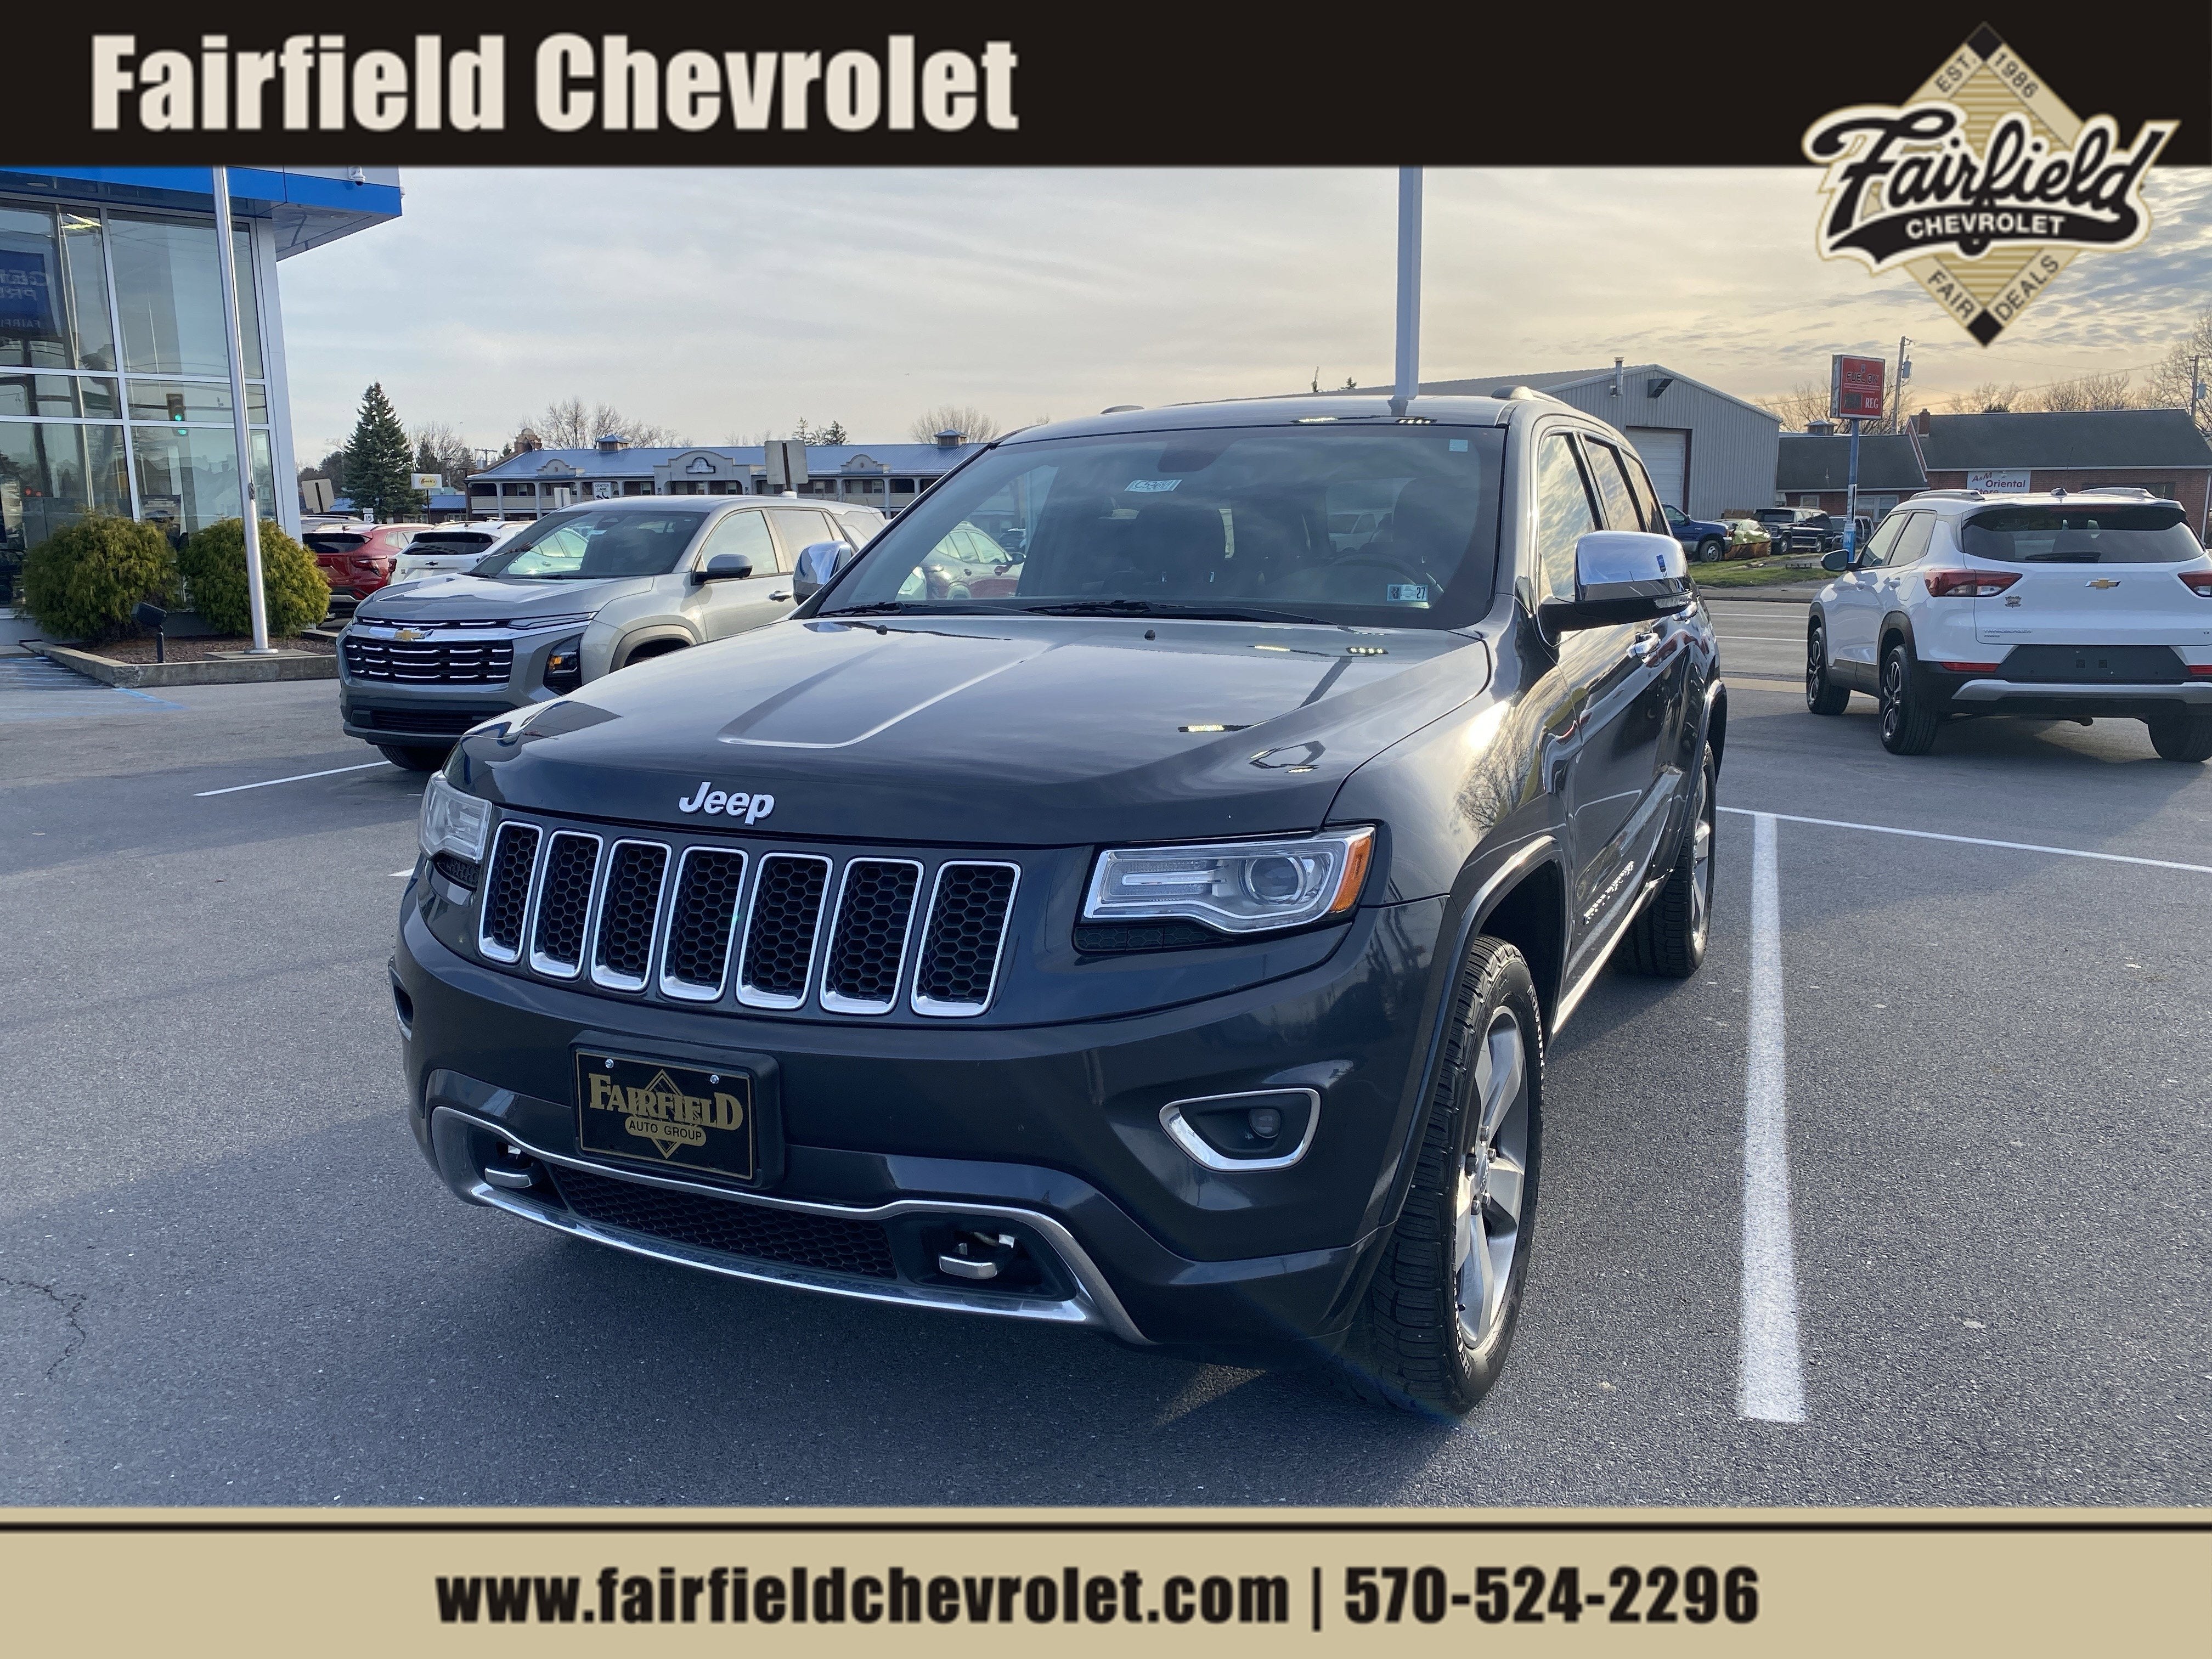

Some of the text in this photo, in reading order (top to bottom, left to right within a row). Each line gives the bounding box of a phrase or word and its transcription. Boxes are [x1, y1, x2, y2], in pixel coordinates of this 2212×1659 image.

[1846, 371, 1880, 383] FUEL ON
[1865, 397, 1878, 409] REG
[1972, 472, 1992, 482] A&M
[1986, 479, 2026, 488] Oriental
[1417, 586, 1425, 600] 27
[679, 781, 775, 826] Jeep
[588, 1073, 743, 1131] FAIRFIELD
[629, 1120, 702, 1141] AUTO GROUP
